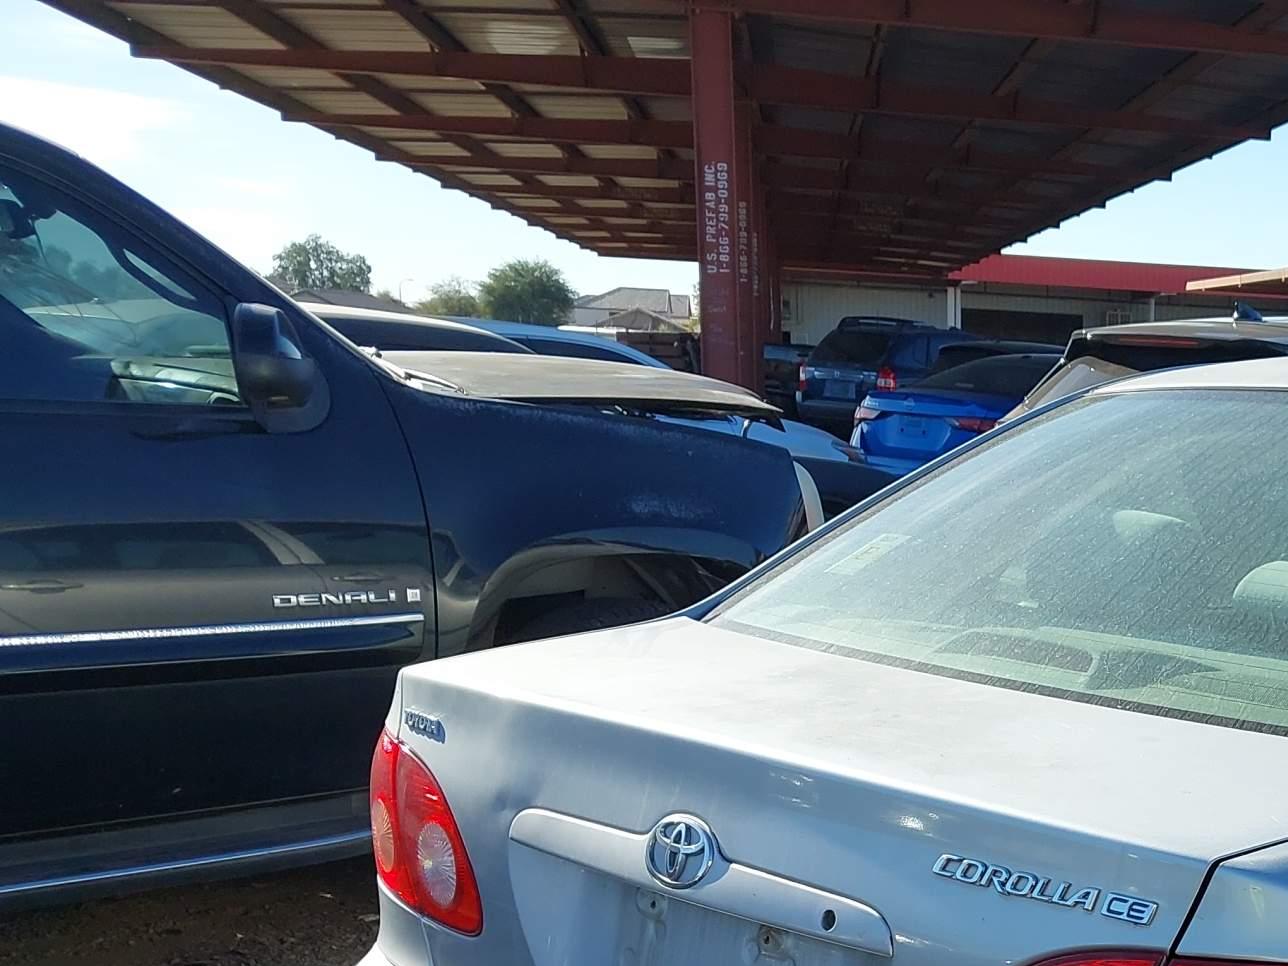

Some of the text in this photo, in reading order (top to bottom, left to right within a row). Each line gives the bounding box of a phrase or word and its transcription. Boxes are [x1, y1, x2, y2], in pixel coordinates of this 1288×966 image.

[703, 161, 717, 273] U.S. PREFAB INC.
[717, 162, 730, 273] 1-866-799-0969
[272, 589, 396, 608] DENALI
[931, 853, 1157, 925] COROLLA CE
